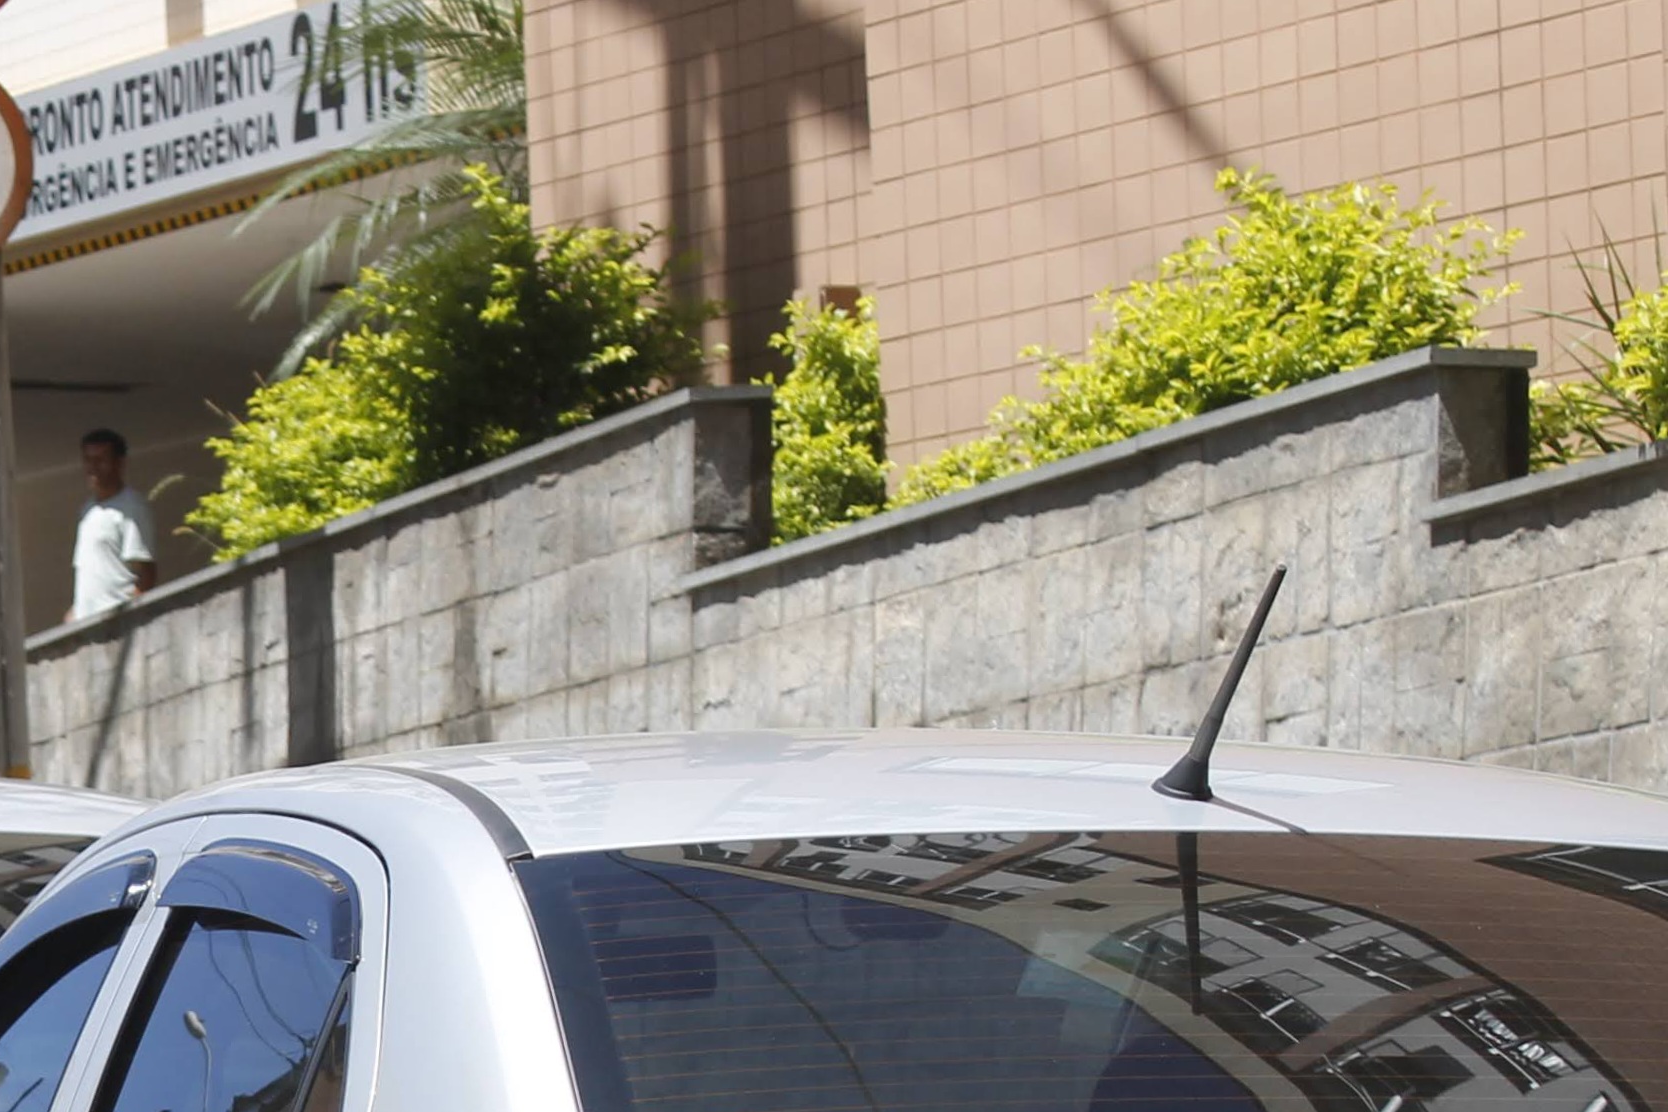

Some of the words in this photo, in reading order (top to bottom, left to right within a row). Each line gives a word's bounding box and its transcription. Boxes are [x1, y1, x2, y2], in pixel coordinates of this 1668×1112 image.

[25, 88, 102, 154] RONTO
[111, 36, 275, 136] ATENDIMENTO
[291, 2, 345, 143] 24
[30, 158, 118, 215] RGÊNCIA
[125, 152, 136, 190] E
[143, 112, 280, 184] EMERGÊNCIA
